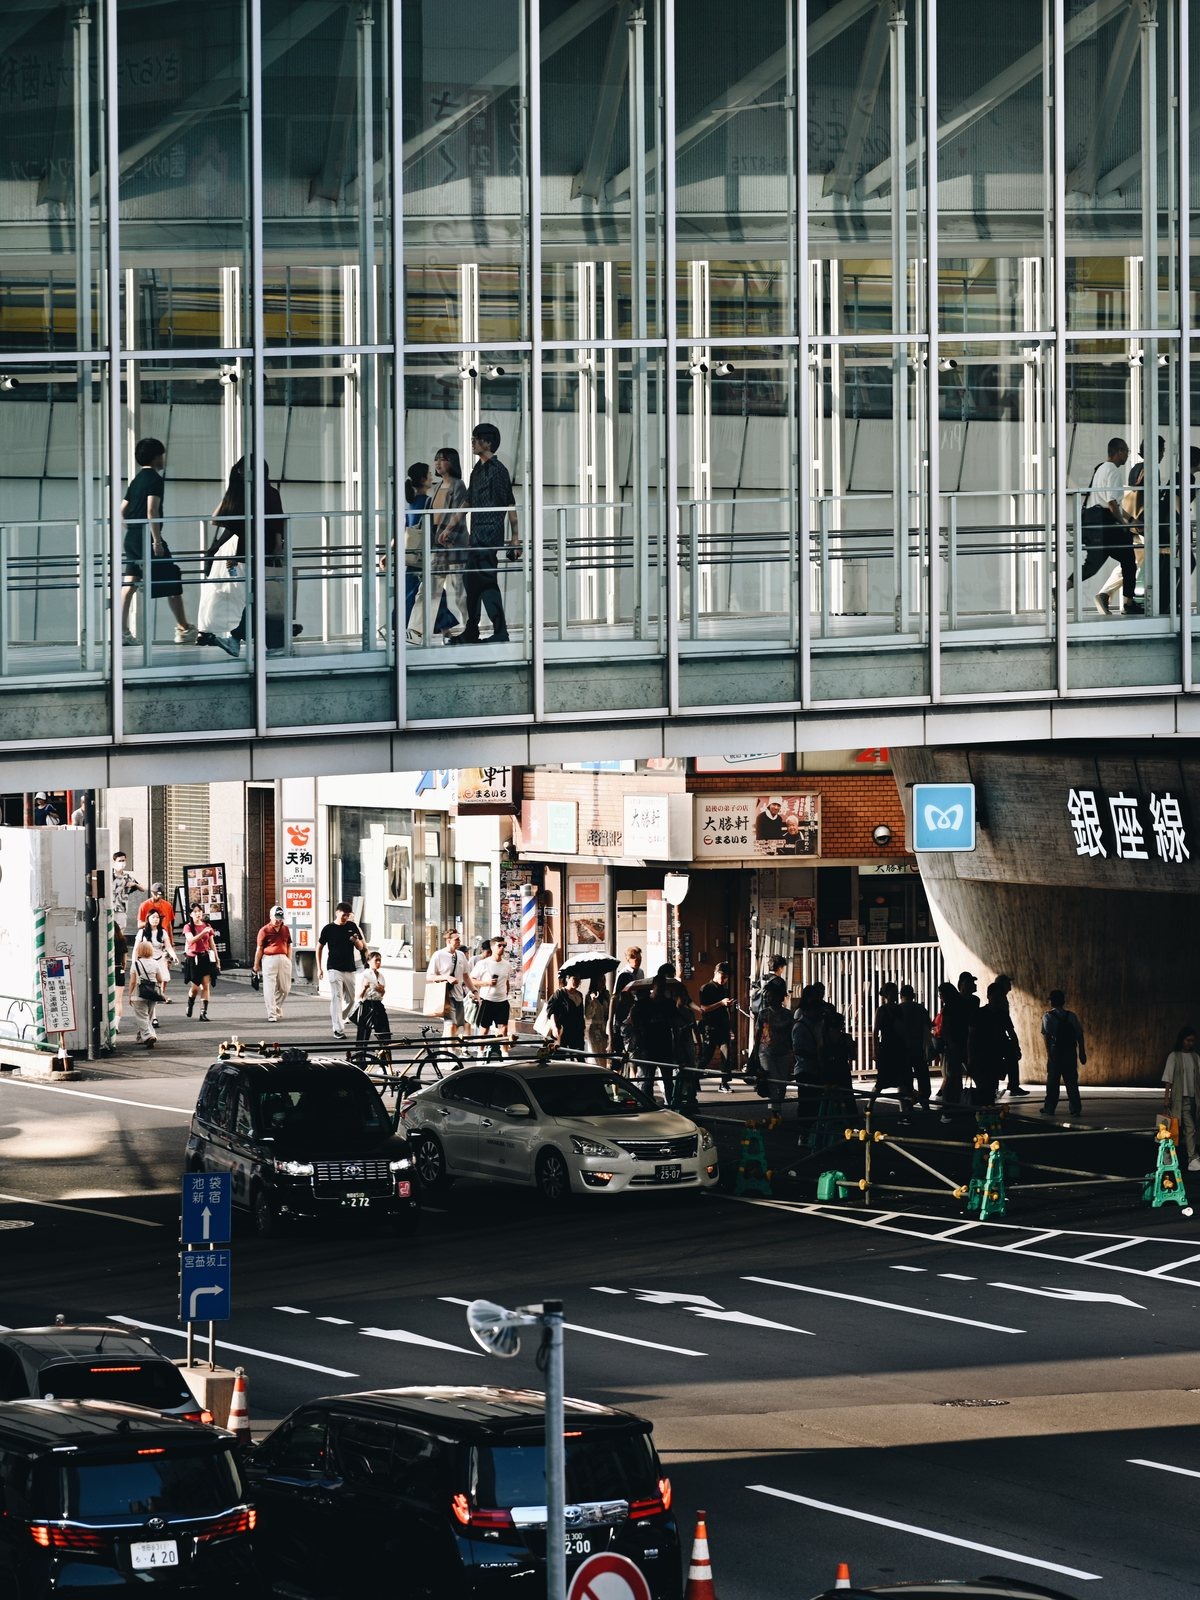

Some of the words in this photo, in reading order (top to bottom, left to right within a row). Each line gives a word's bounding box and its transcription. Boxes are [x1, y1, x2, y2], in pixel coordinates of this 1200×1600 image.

[482, 766, 510, 787] 軒
[476, 790, 507, 798] まるいち
[705, 804, 749, 812] 最後の弟子の店
[702, 816, 749, 832] 大勝軒
[1067, 788, 1190, 863] 銀座線
[715, 835, 748, 845] まるいち
[285, 852, 313, 865] 天狗
[58, 980, 70, 1027] 駐車場出入口につき
[660, 1170, 680, 1180] 25-07
[192, 1177, 222, 1190] 池袋
[192, 1191, 222, 1204] 新宿
[184, 1254, 227, 1268] 宮益坂上
[565, 1541, 591, 1554] 2-00
